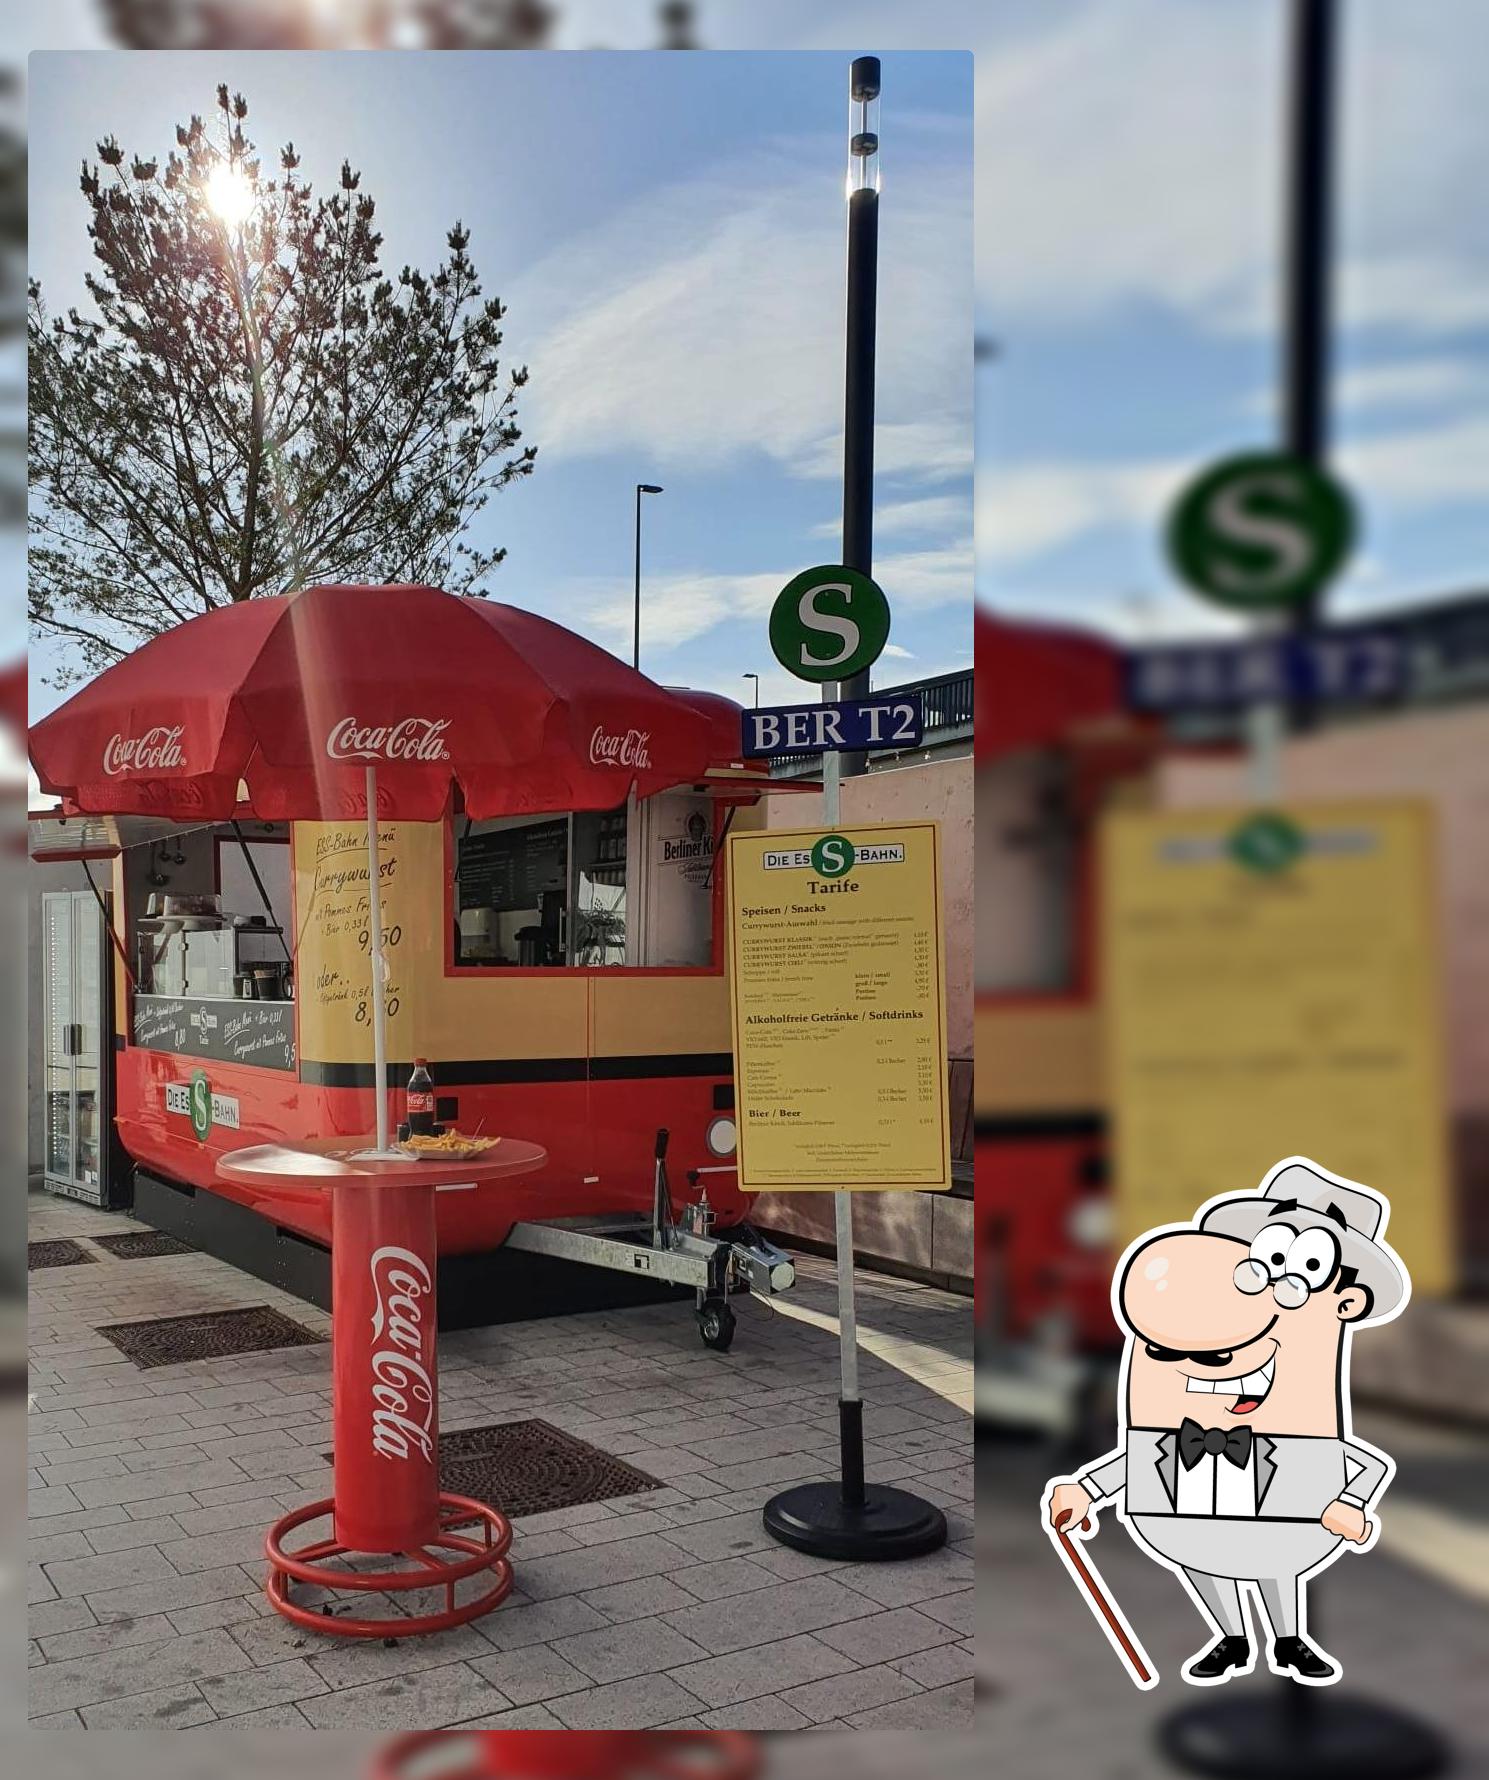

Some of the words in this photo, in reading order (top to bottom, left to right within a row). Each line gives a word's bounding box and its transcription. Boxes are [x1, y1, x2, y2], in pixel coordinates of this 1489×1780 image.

[798, 582, 860, 667] S
[326, 716, 453, 761] Coca-Cola
[751, 709, 846, 750] BER
[858, 704, 916, 742] T2
[103, 725, 186, 775] Coca-Cola
[589, 725, 652, 769] Coca-Cola
[664, 839, 702, 861] Berliner
[767, 855, 789, 866] DIE
[821, 840, 845, 873] S
[314, 857, 397, 894] Currywust
[806, 879, 860, 894] Tarife
[741, 906, 781, 918] Speisen
[791, 903, 826, 914] Snacks
[354, 997, 400, 1027] 8,0
[745, 1013, 809, 1024] Alkoholfreie
[811, 1012, 859, 1022] Getränke
[869, 1009, 924, 1020] Softdrinks
[168, 1088, 179, 1108] DIE
[194, 1079, 207, 1131] S
[749, 1109, 769, 1117] Bier
[779, 1109, 802, 1117] Beer
[370, 1246, 433, 1463] Coca-Cola
